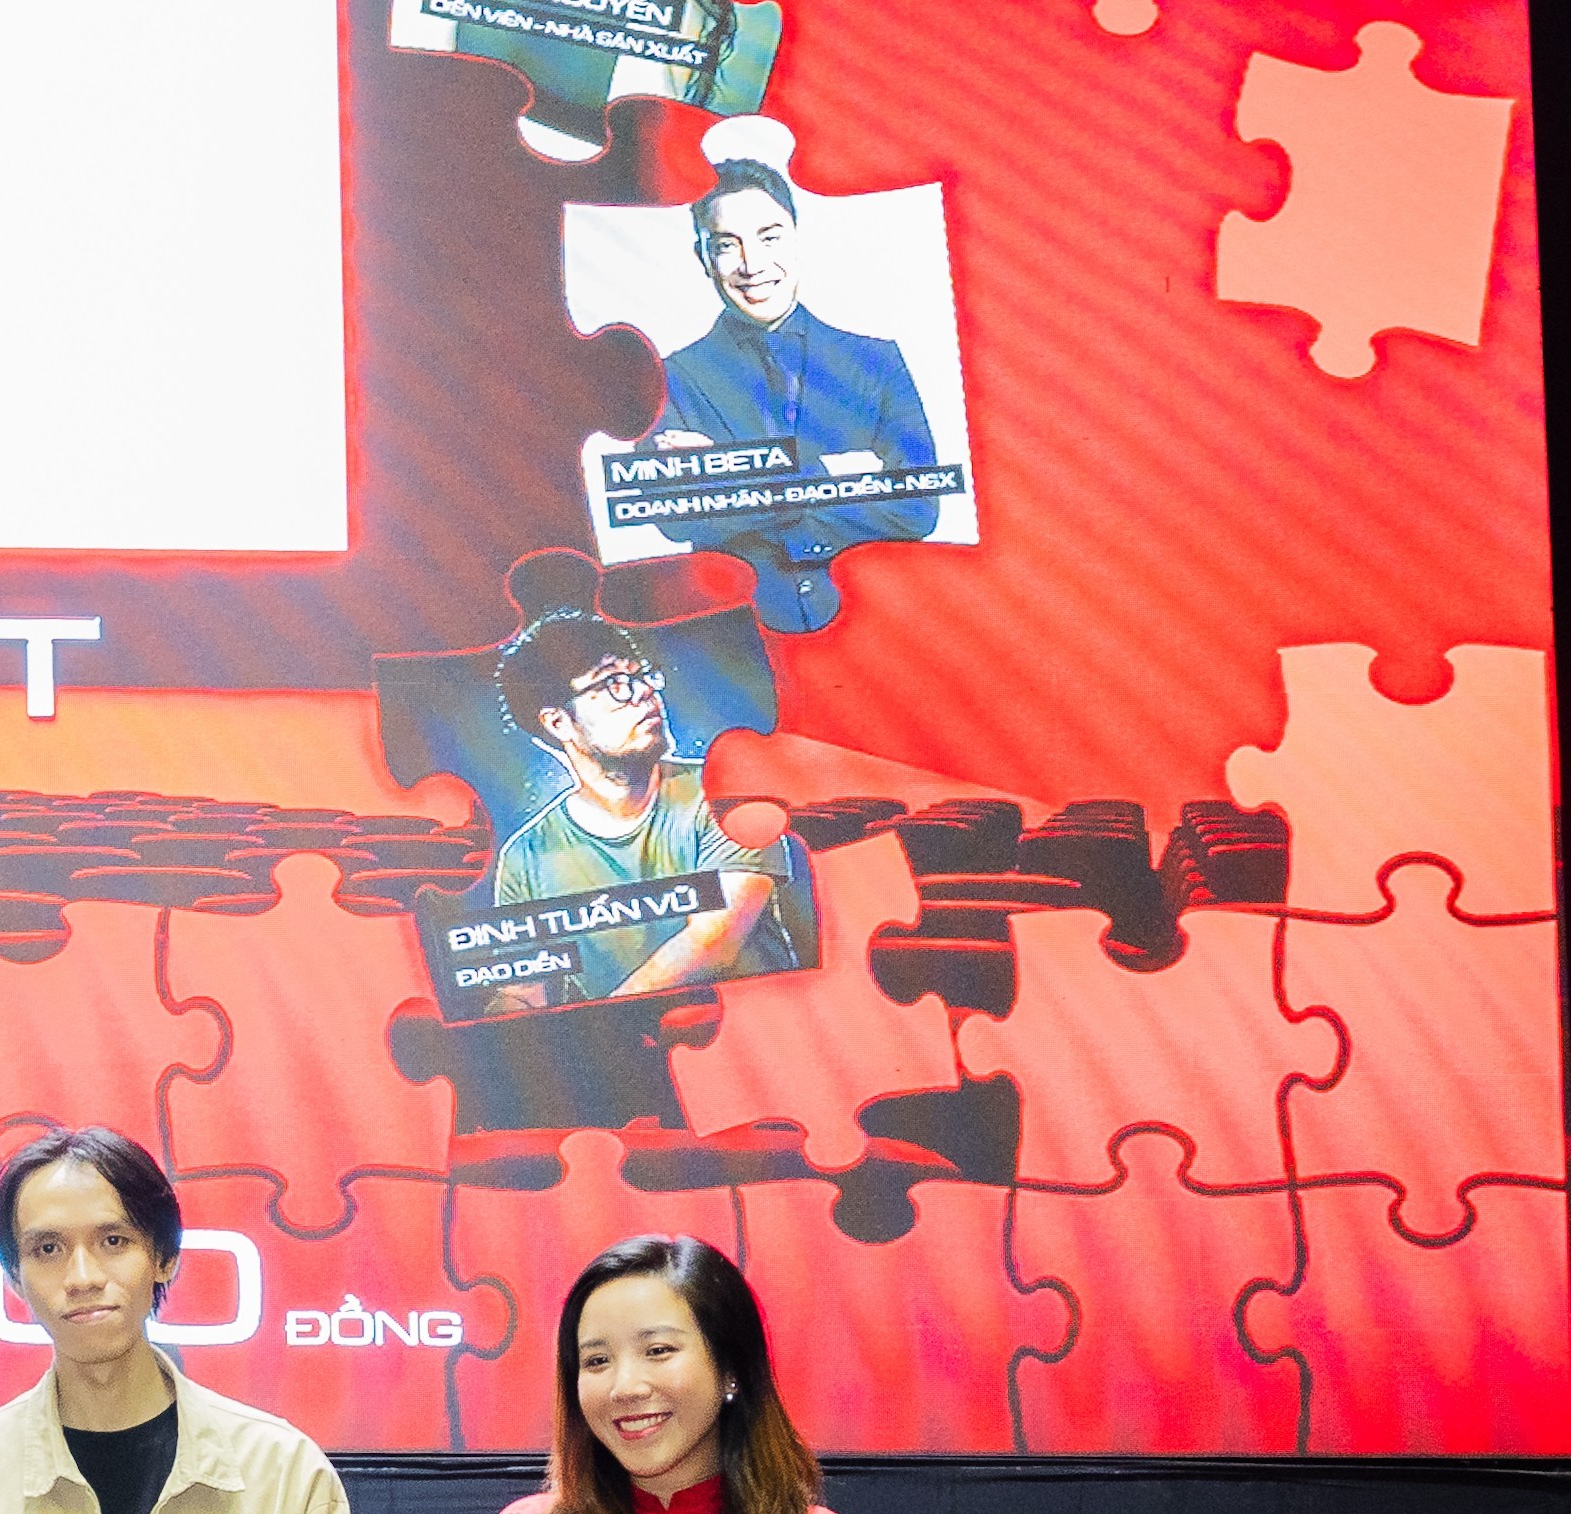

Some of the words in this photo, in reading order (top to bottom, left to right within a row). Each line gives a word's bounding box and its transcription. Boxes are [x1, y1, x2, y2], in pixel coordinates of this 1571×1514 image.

[611, 454, 703, 484] MINH
[704, 446, 793, 474] BETA
[615, 496, 702, 520] DOANH
[448, 914, 537, 951] ĐINH
[539, 893, 642, 934] TUẤN
[643, 884, 700, 916] VŨ
[285, 1296, 463, 1347] ĐỒNG
